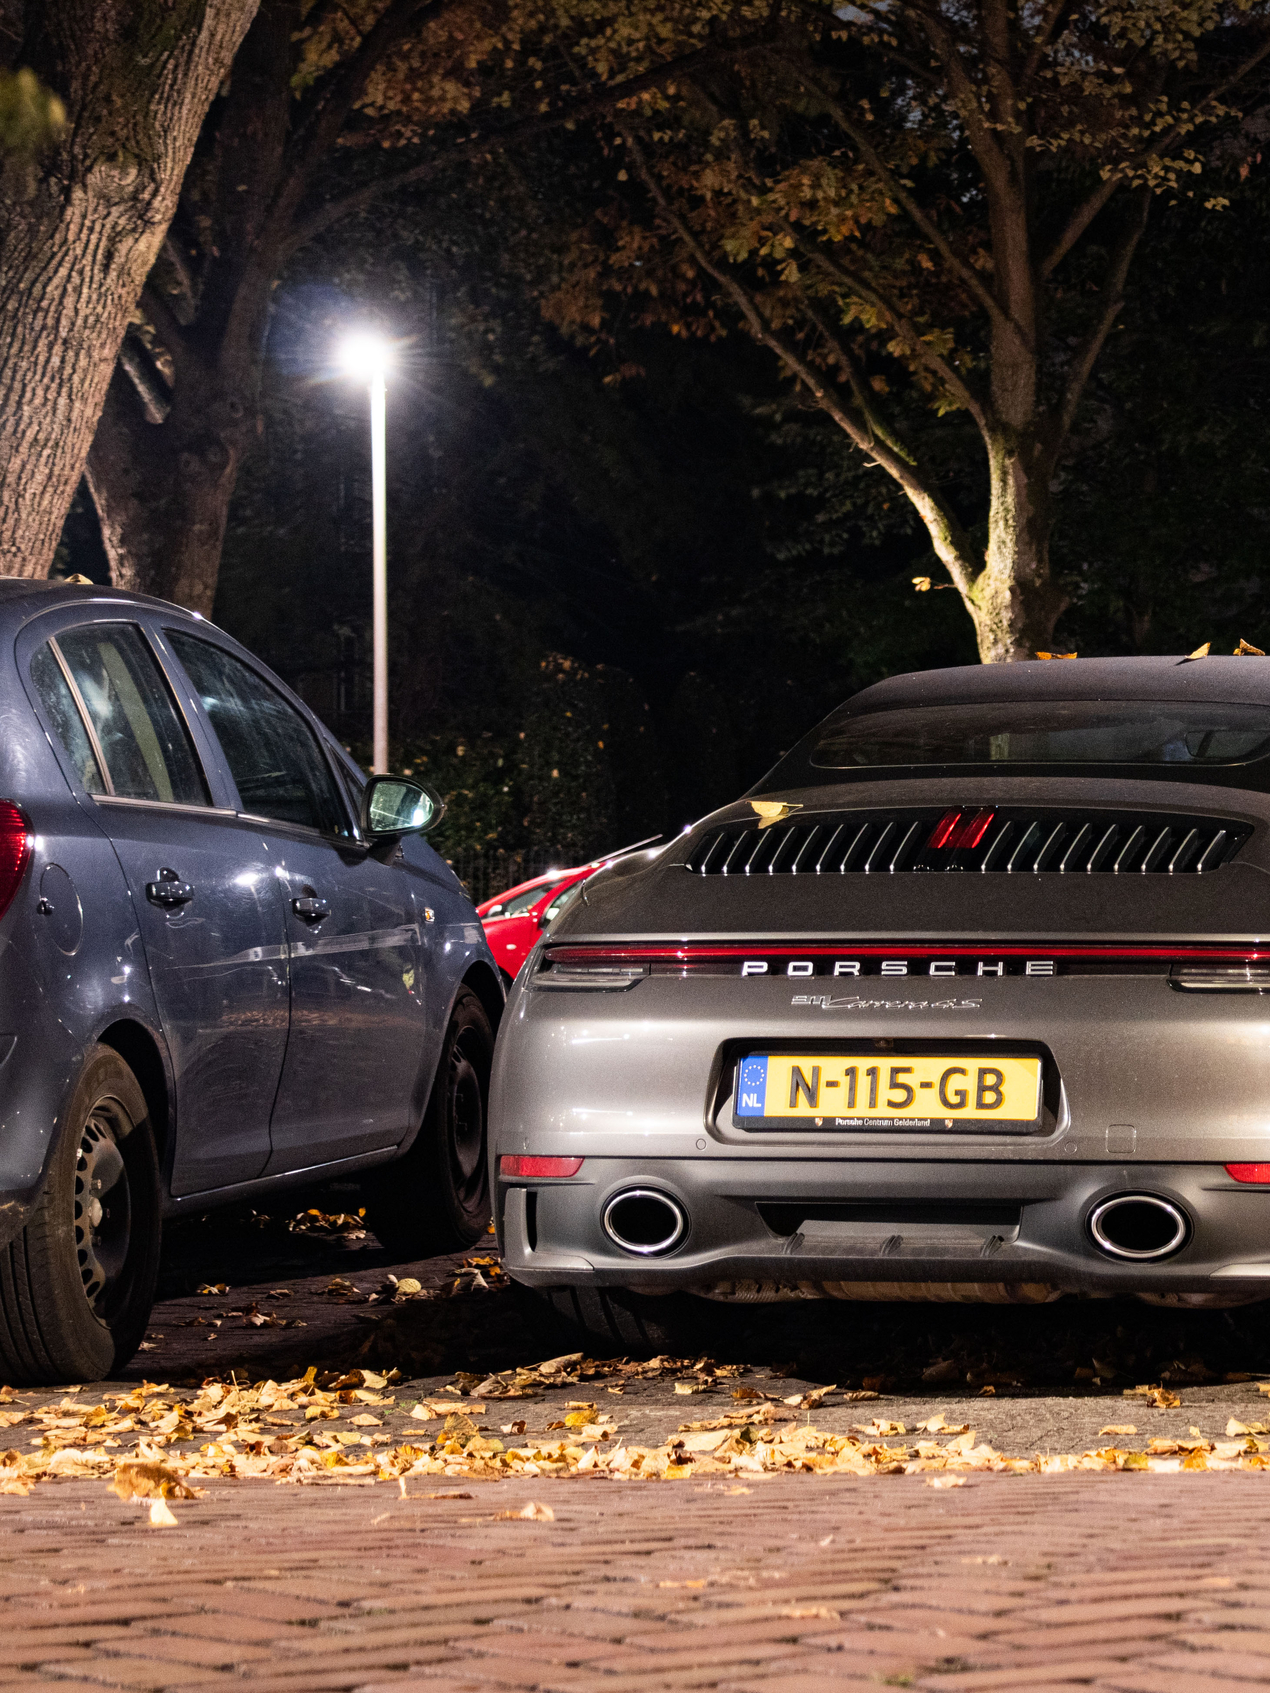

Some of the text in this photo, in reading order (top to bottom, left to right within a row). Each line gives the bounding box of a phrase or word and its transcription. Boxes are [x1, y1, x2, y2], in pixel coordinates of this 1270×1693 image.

[741, 961, 1055, 977] PORSCHE
[822, 996, 929, 1010] Carrera
[789, 1065, 1005, 1110] N-115-GB
[742, 1094, 762, 1107] NL
[835, 1117, 930, 1127] Porsche Centrum Gelderland
